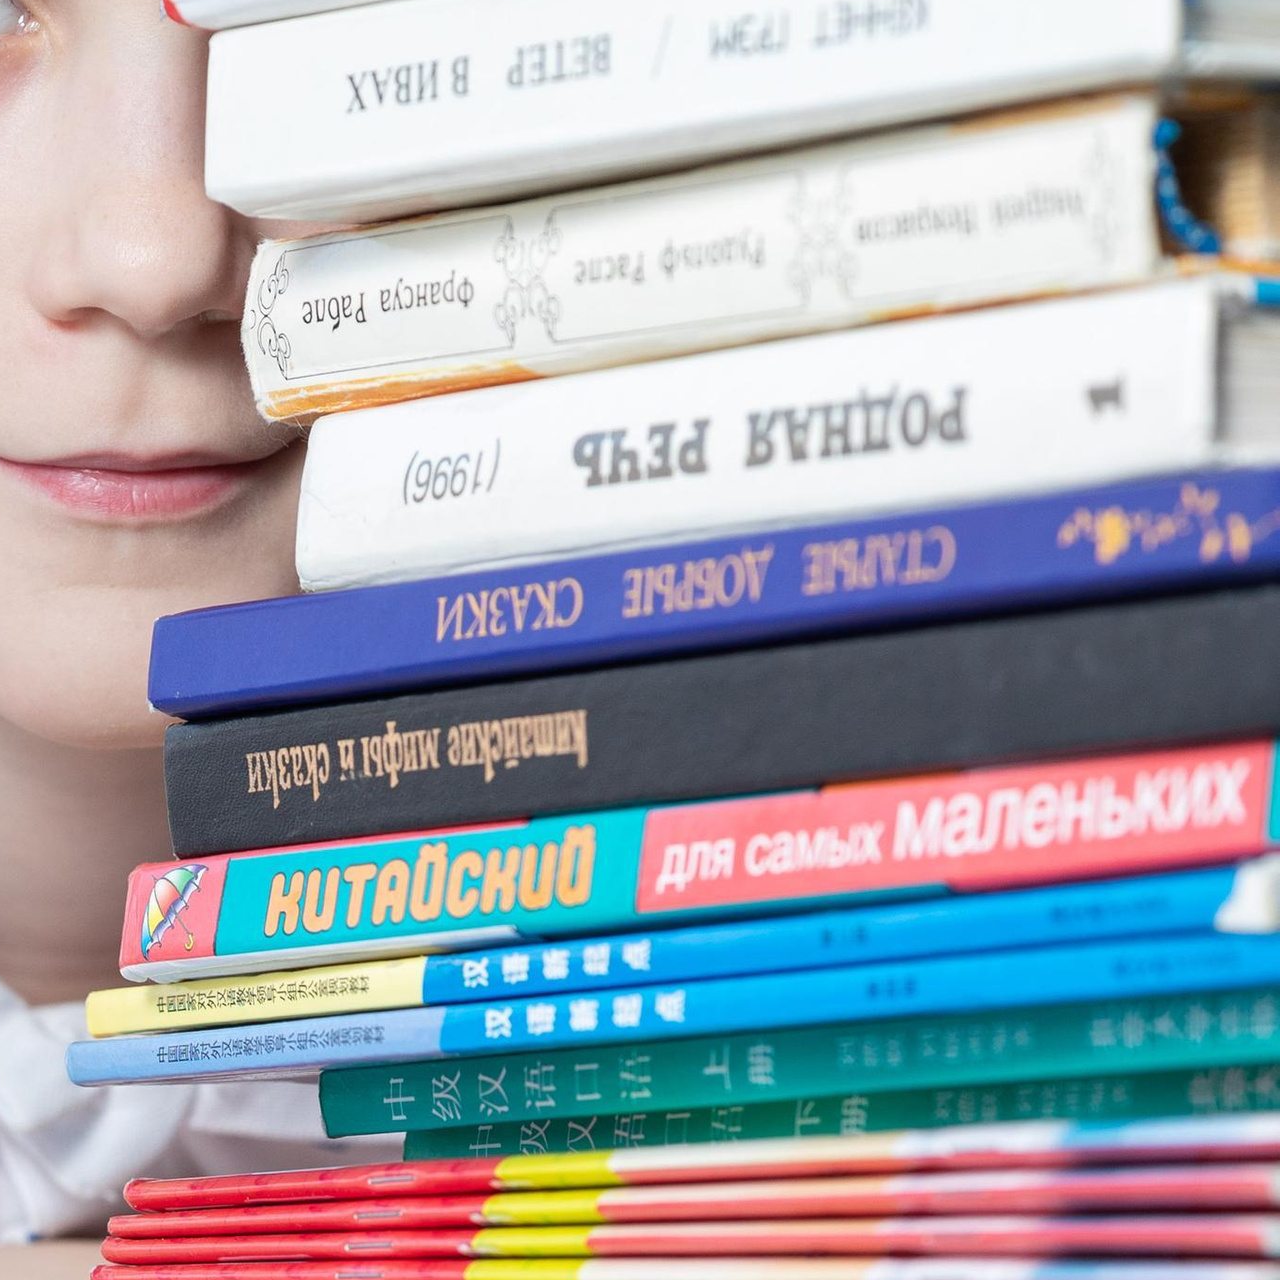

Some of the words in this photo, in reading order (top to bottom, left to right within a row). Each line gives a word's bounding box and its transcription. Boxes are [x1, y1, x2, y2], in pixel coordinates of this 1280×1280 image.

[346, 60, 439, 113] ИВАХ
[451, 56, 471, 97] В
[506, 33, 612, 88] ВЕТЕР
[380, 270, 475, 312] Франсуа
[573, 253, 645, 285] Распе
[301, 290, 367, 332] Рабле
[574, 419, 712, 488] РЕЧЬ
[745, 385, 967, 467] РОДНАЯ
[403, 436, 499, 505] (1996)
[621, 543, 775, 619] ДОБРЫЕ
[800, 524, 957, 596] СТАРЫЕ
[436, 577, 584, 643] СКАЗКИ
[247, 736, 331, 810] сказки
[655, 836, 734, 892] для
[744, 819, 885, 876] самых
